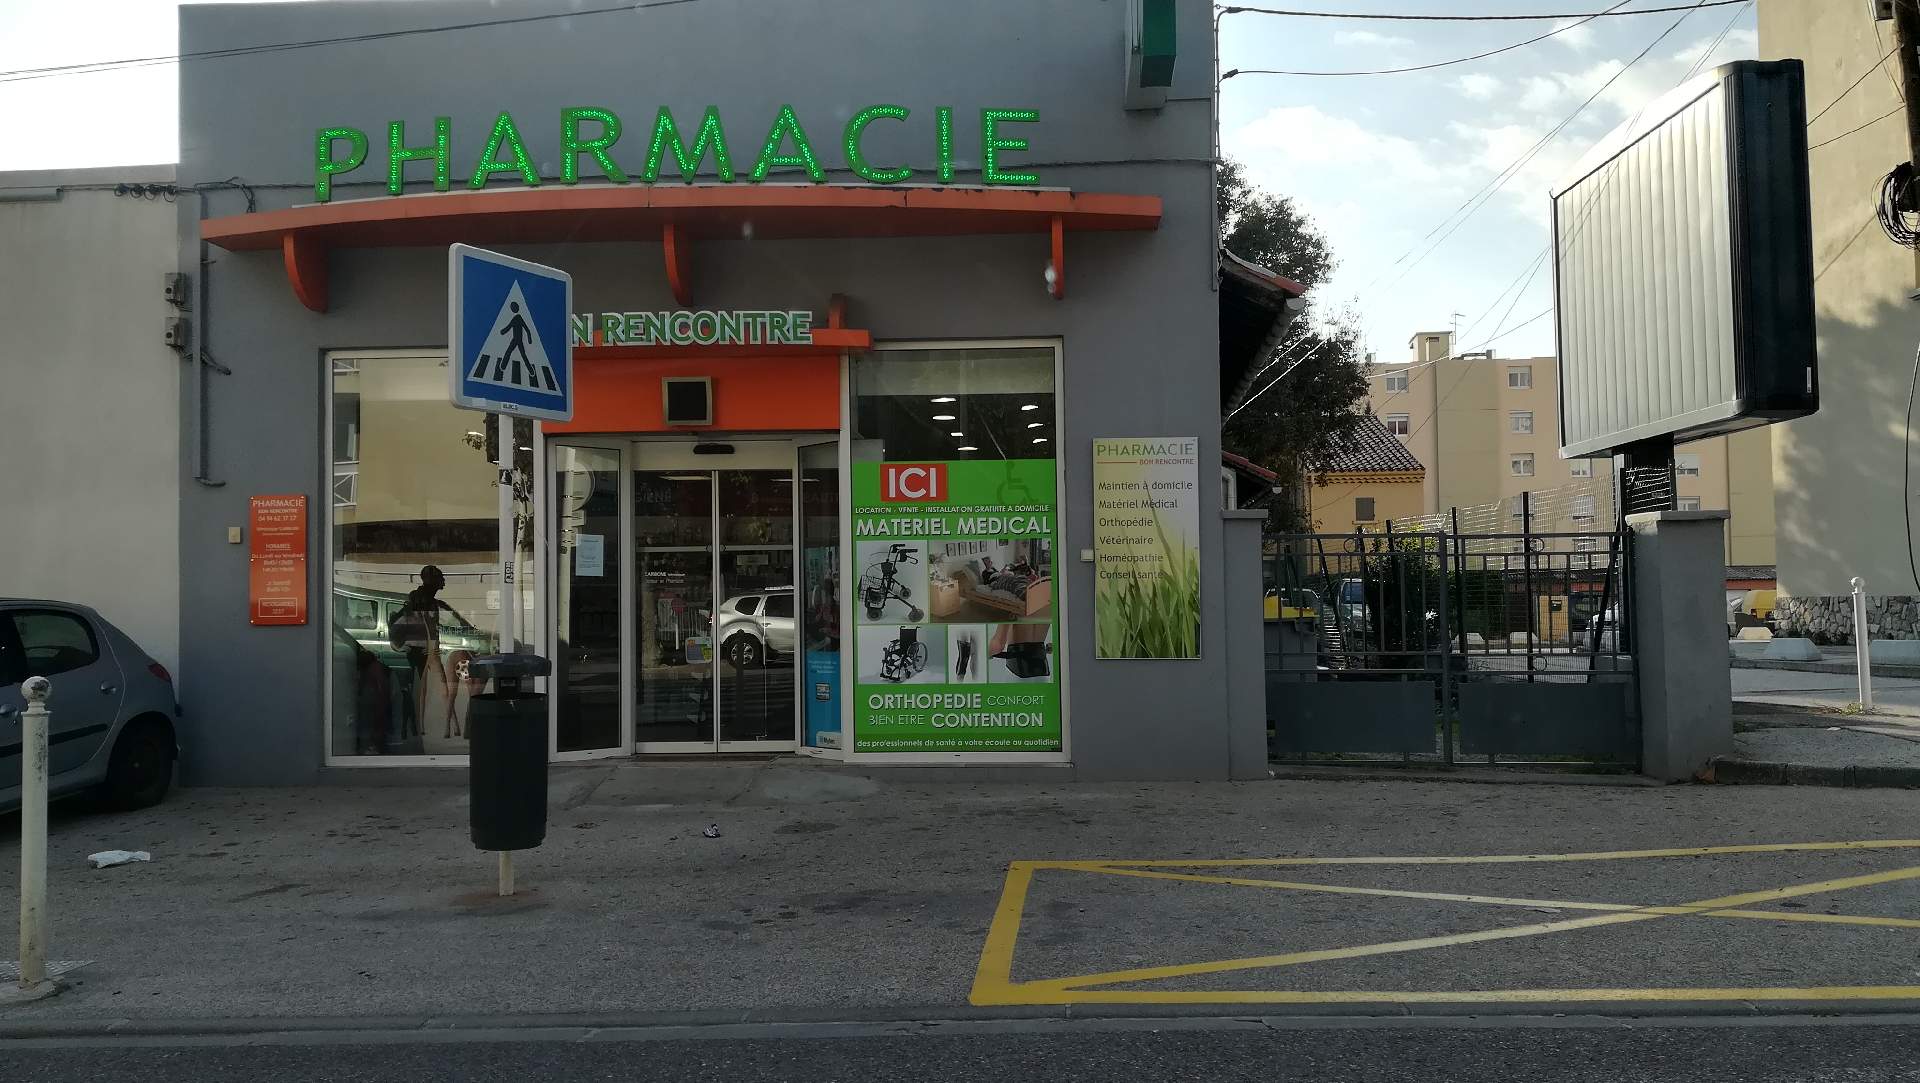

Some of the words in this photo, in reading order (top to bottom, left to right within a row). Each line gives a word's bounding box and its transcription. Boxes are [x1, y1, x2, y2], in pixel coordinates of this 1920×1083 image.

[314, 103, 1041, 202] PHARMACIE
[601, 311, 813, 346] RENCONTRE
[1096, 443, 1195, 456] PHARMACIE
[888, 467, 937, 498] ICI
[1098, 481, 1140, 490] Maintien
[1151, 481, 1193, 490] domicile
[252, 499, 304, 507] PHARMACIE
[1098, 499, 1139, 509] Matériel
[1141, 499, 1178, 508] Médical
[856, 518, 951, 536] MATERIEL
[957, 516, 1051, 535] MEDICAL
[1099, 517, 1154, 528] Orthopédie
[1099, 536, 1154, 545] Vétérinaire
[1100, 553, 1164, 564] Homéopathie
[1100, 570, 1135, 579] Conseil
[868, 693, 982, 710] ORTHOPEDIE
[987, 695, 1045, 706] CONFORT
[869, 714, 894, 725] BIEN
[898, 714, 925, 725] ETRE
[931, 713, 1043, 728] CONTENTION
[857, 739, 871, 747] des
[871, 739, 923, 748] professionnels
[1024, 738, 1059, 747] quotidien
